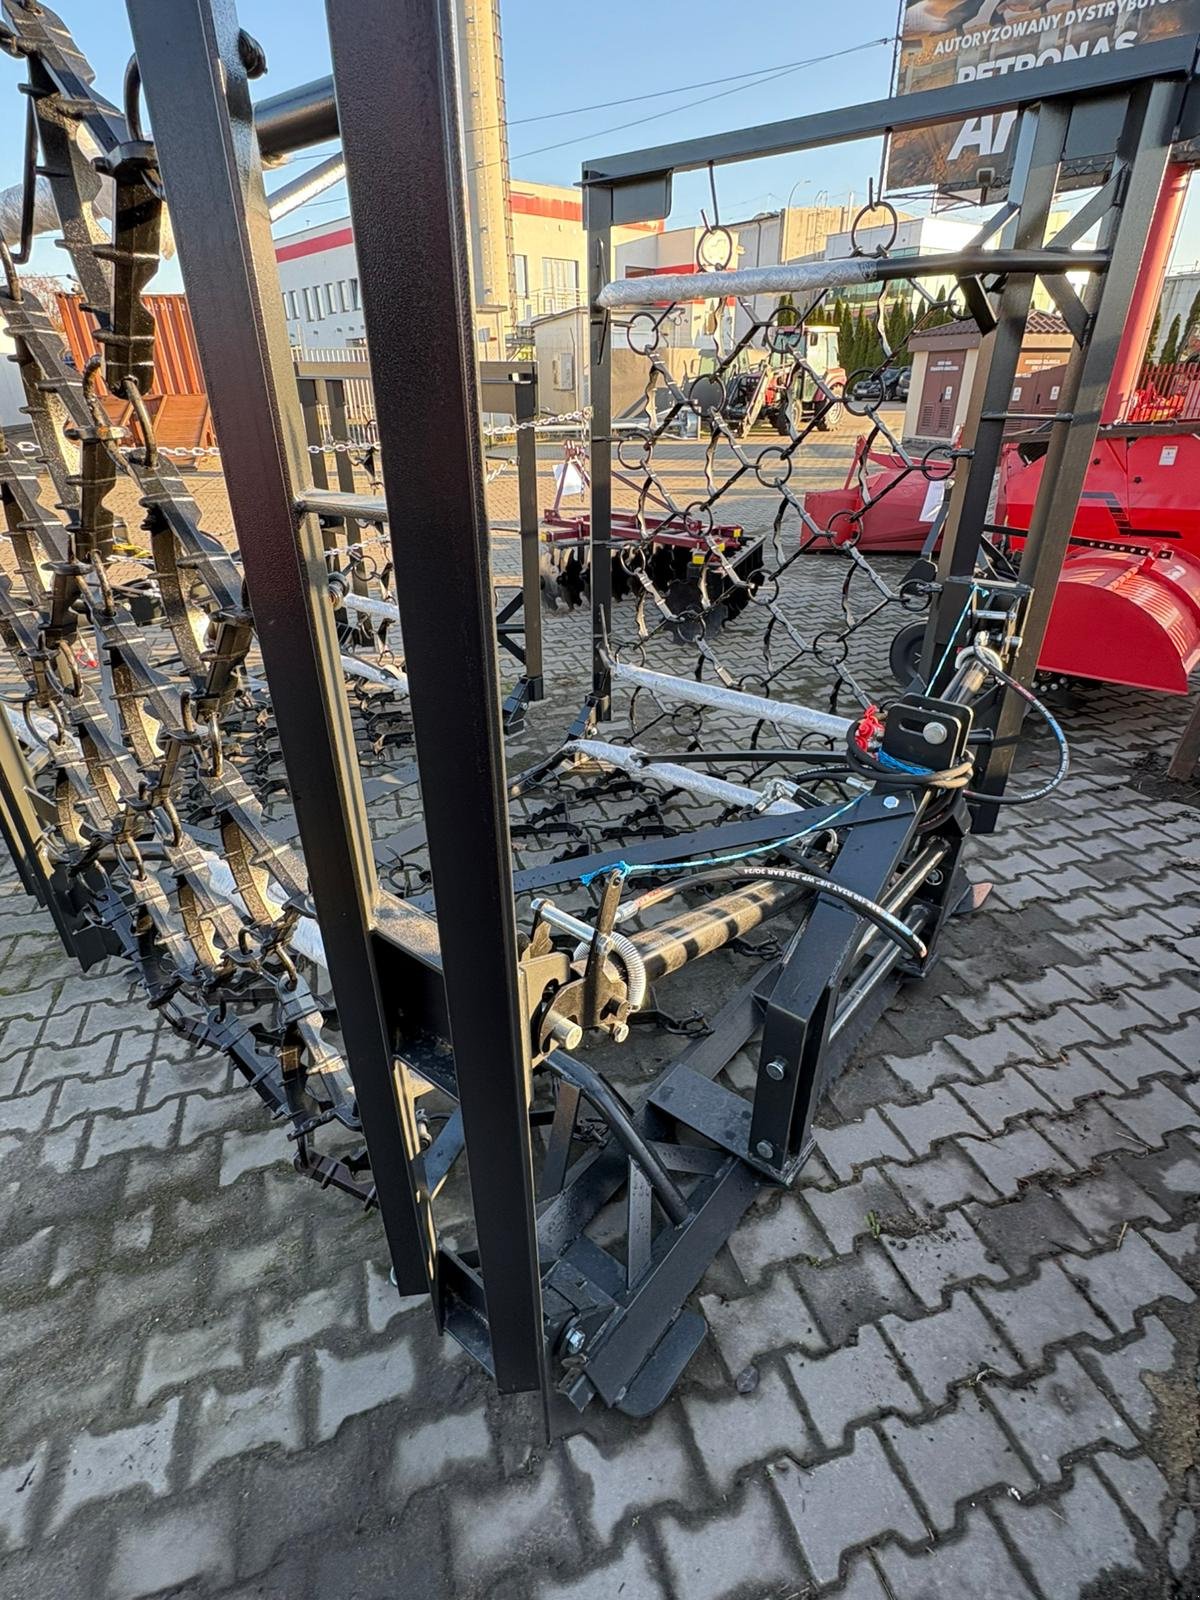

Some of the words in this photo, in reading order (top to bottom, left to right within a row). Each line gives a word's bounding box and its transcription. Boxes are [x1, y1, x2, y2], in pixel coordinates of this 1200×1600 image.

[934, 14, 1061, 56] AUTORYZOWANY
[767, 868, 785, 876] BAR
[802, 875, 815, 883] WP
